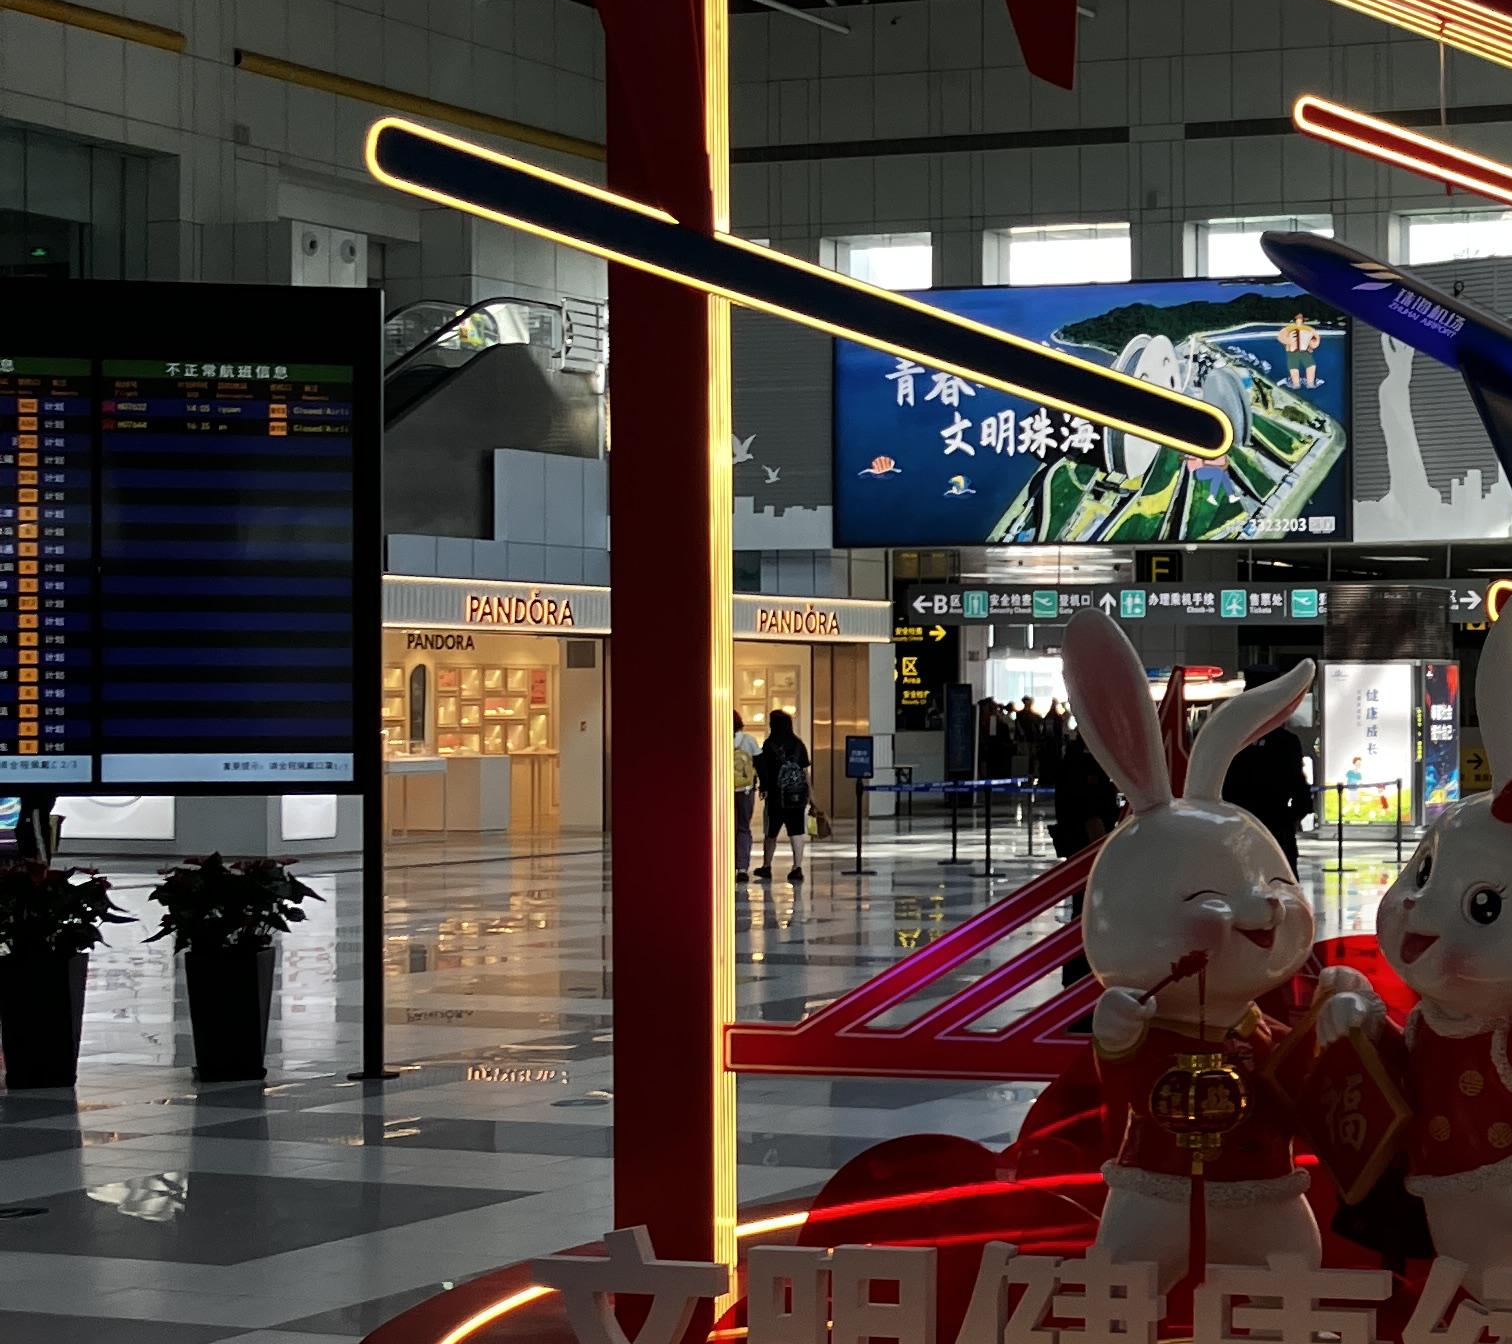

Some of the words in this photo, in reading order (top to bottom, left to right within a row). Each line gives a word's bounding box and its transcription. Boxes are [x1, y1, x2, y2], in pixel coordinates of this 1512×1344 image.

[165, 362, 289, 380] 不正常航班信息
[940, 407, 1101, 458] 文明珠海
[464, 589, 575, 626] PANDORA
[933, 594, 948, 615] B
[989, 594, 1032, 607] 安全检查
[1059, 594, 1091, 606] 登机口
[755, 603, 841, 636] PANDORA
[406, 632, 475, 651] PANDORA
[902, 656, 918, 676] 区
